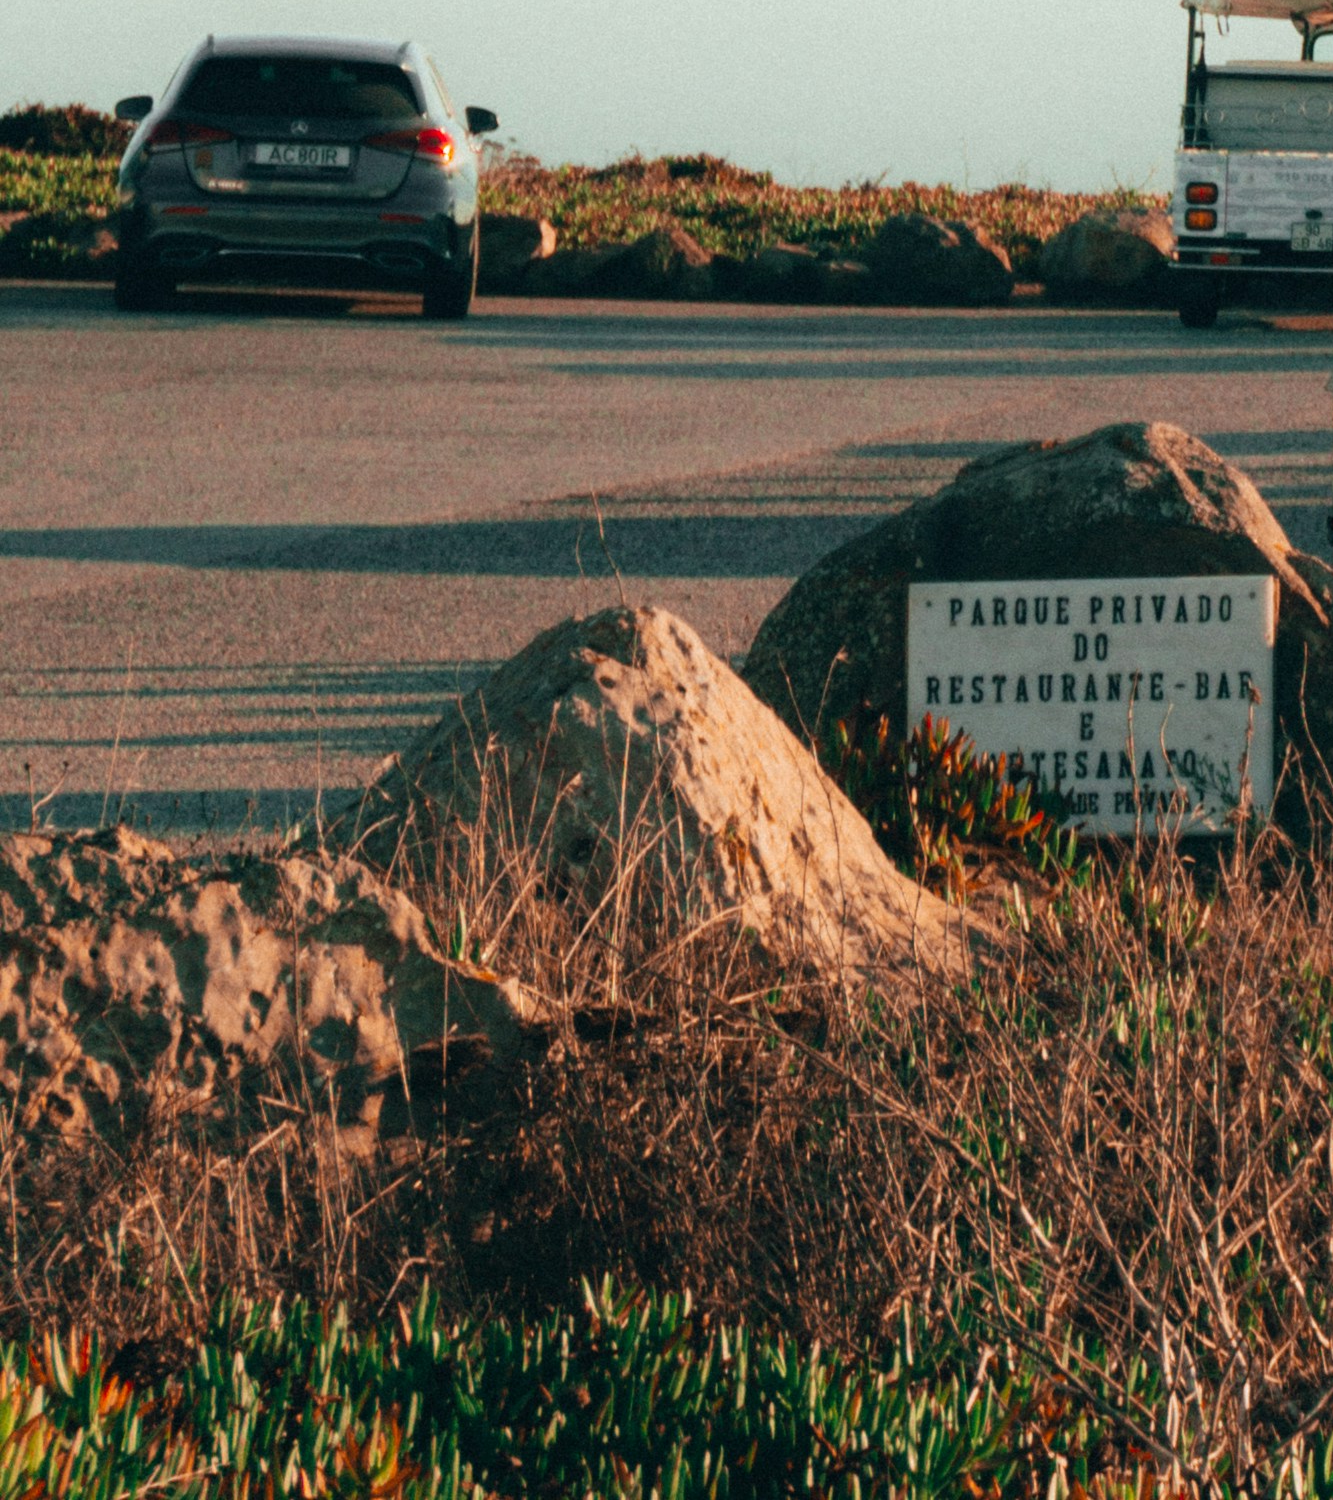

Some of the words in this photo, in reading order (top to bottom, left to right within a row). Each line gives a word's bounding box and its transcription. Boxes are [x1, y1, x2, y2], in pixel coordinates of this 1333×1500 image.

[949, 596, 1071, 627] PARQUE
[1089, 594, 1234, 625] PRIVADO
[1073, 632, 1110, 662] DO
[1079, 711, 1095, 741] E
